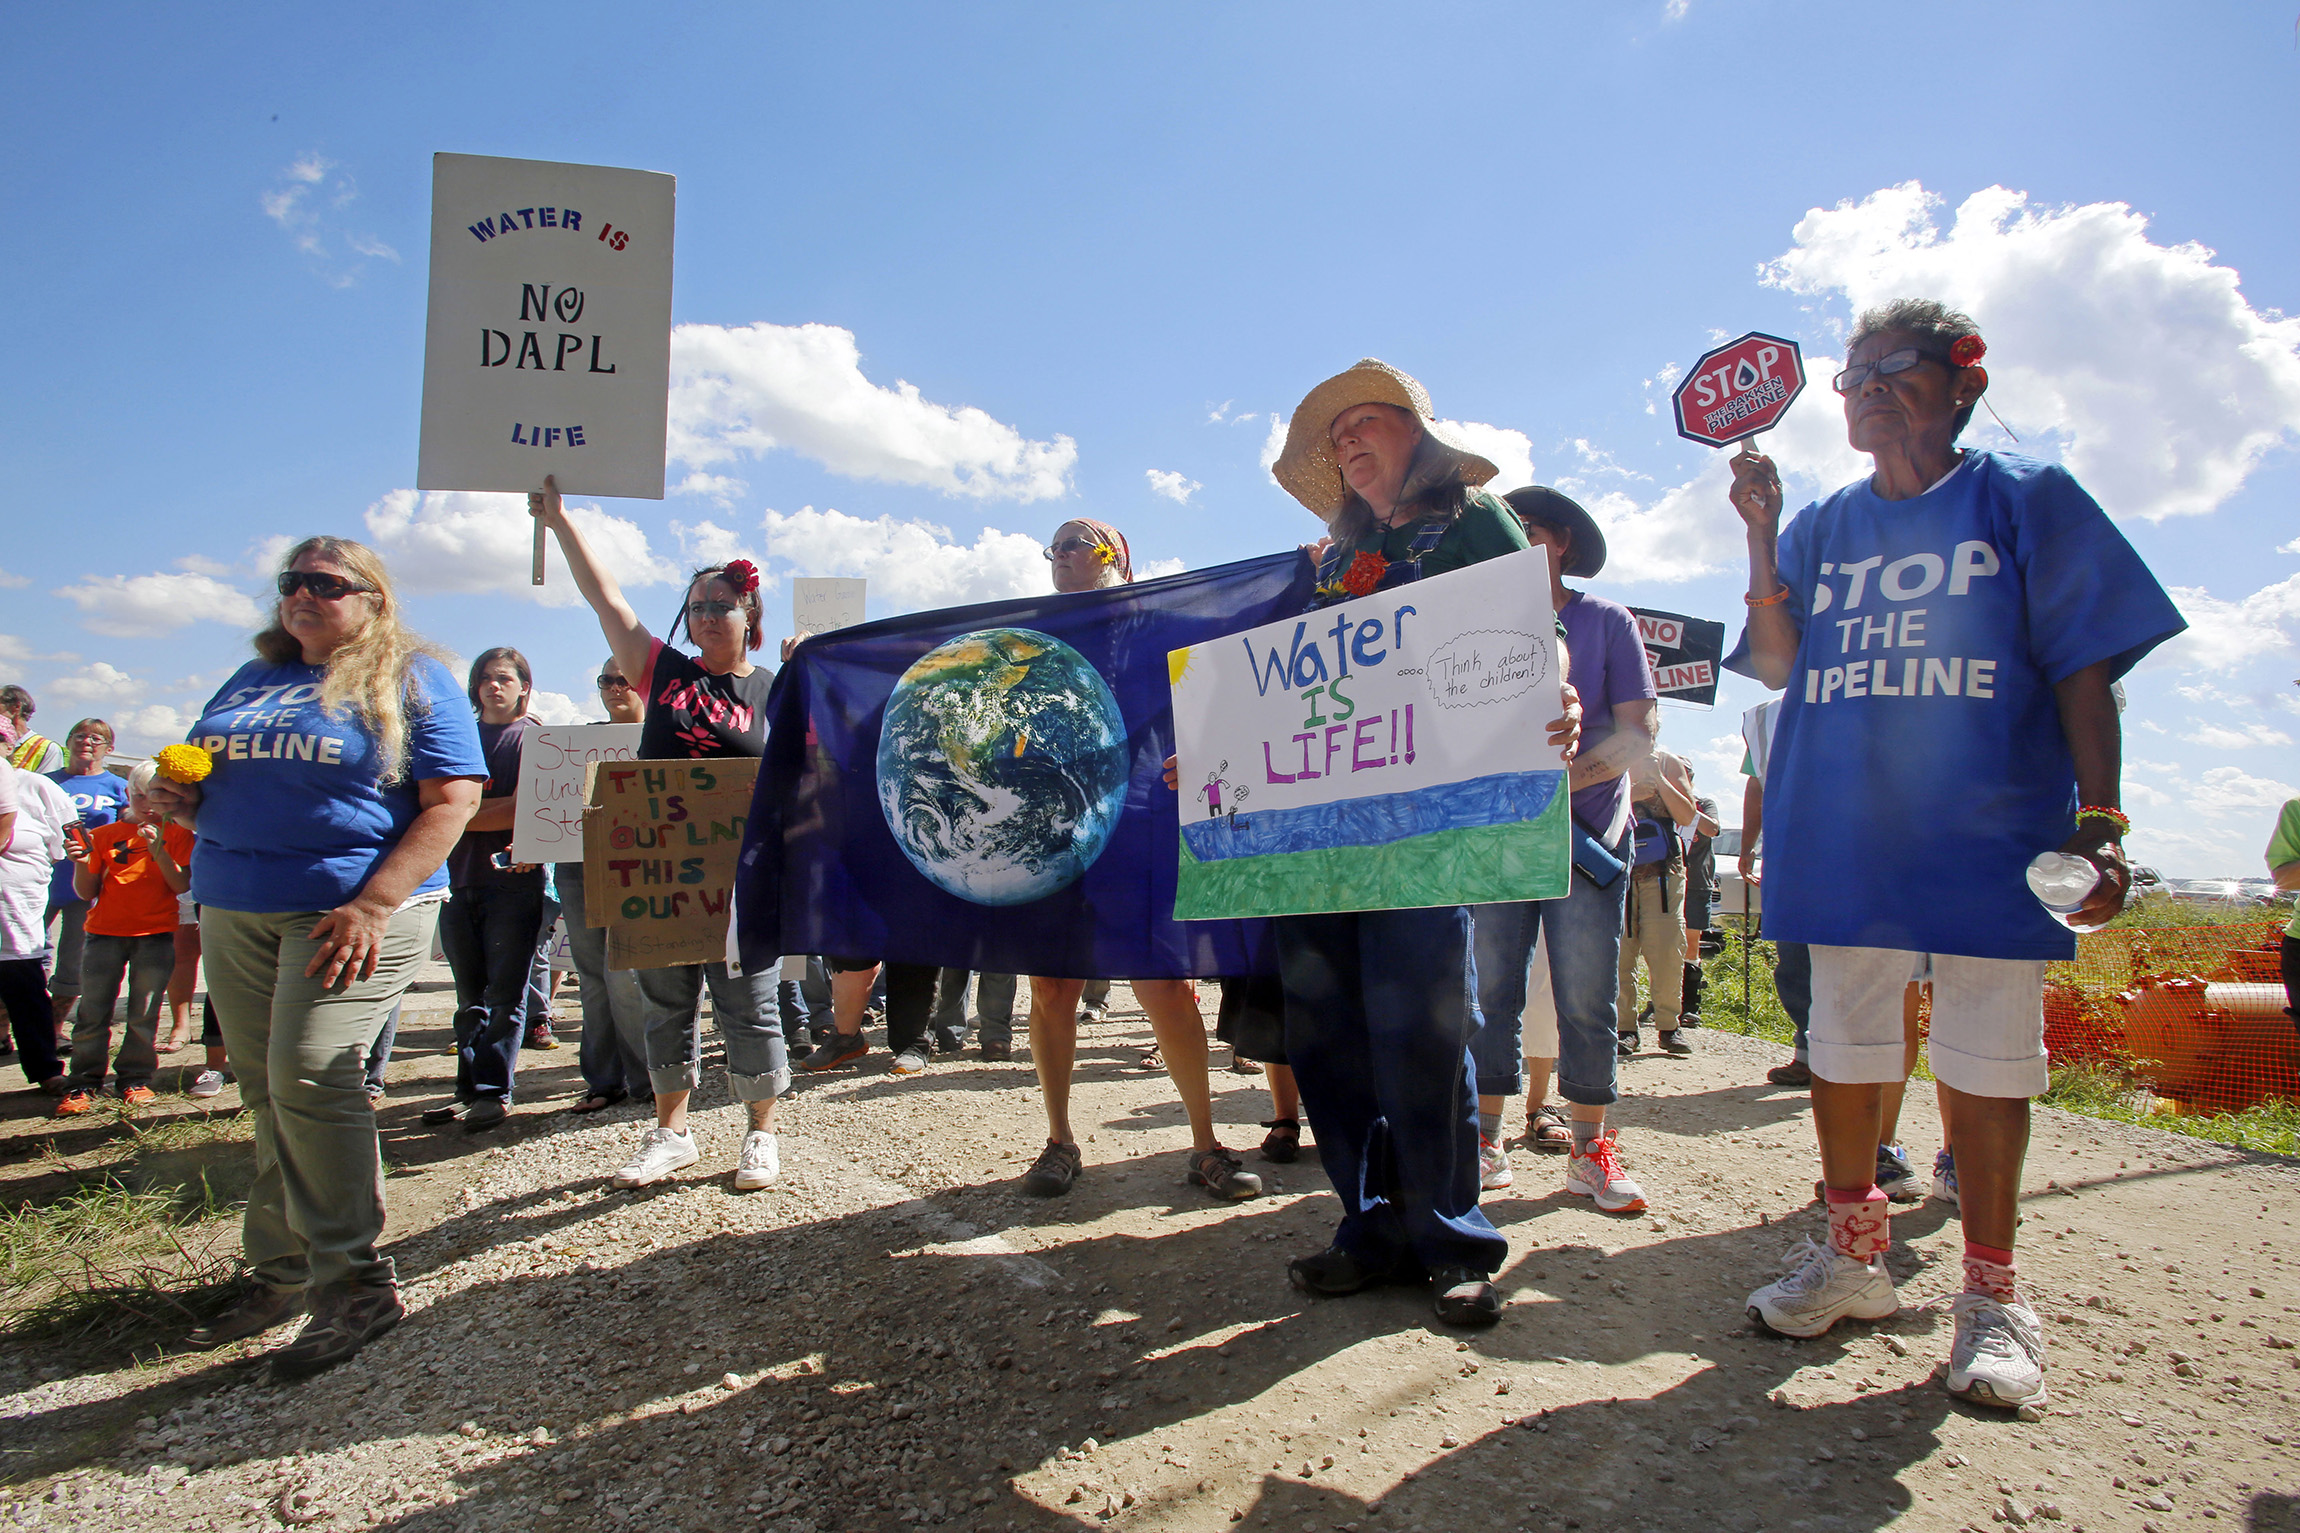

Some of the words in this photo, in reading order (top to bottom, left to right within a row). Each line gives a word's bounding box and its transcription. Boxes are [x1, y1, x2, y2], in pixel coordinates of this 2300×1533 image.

[467, 206, 583, 243] WATER
[598, 222, 630, 251] IS
[518, 282, 585, 323] NO
[480, 328, 616, 374] DAPL
[1694, 345, 1779, 407] STOP
[1703, 407, 1726, 423] THE
[1726, 376, 1784, 413] BAKKEN
[1707, 385, 1788, 435] PIPELINE
[511, 423, 586, 448] LIFE
[1811, 539, 2000, 617] STOP
[1243, 604, 1417, 697] Water
[1638, 618, 1678, 643] NO
[1835, 608, 1927, 654] THE
[1435, 649, 1481, 680] Think
[1497, 643, 1538, 668] about
[1445, 678, 1468, 698] the
[1479, 660, 1535, 689] children!
[1805, 656, 1997, 704] IPELINE
[211, 682, 324, 713] STO
[229, 707, 302, 729] THE
[1300, 674, 1355, 729] IS
[192, 732, 344, 765] PELINE
[1262, 703, 1416, 784] LIFE!!
[534, 777, 584, 803] Uni
[608, 766, 717, 794] THIS
[648, 795, 689, 822] IS
[607, 857, 706, 888] THIS
